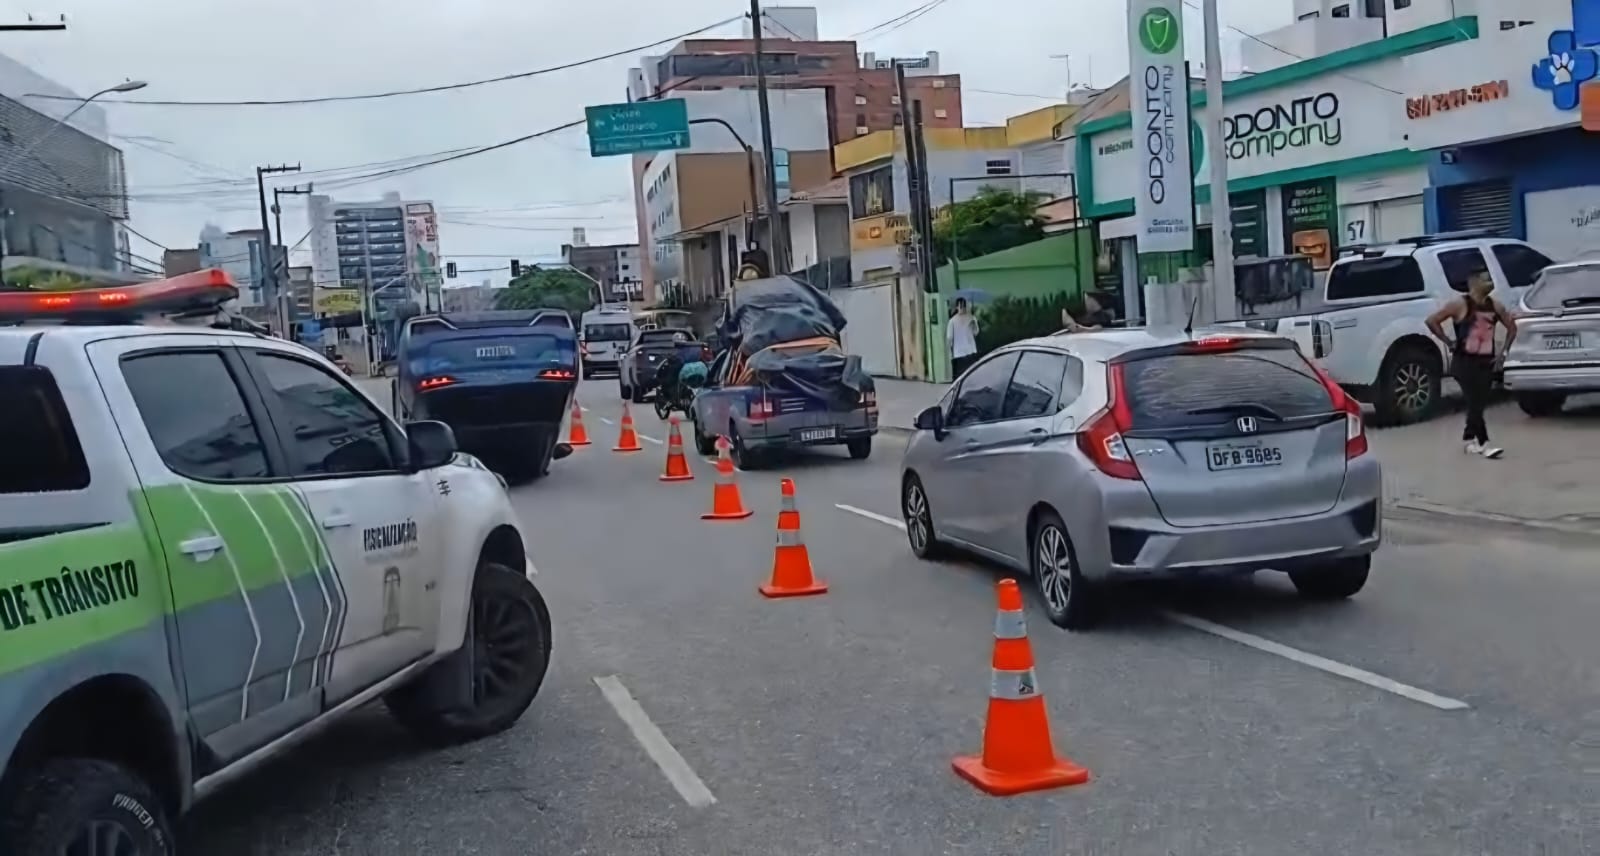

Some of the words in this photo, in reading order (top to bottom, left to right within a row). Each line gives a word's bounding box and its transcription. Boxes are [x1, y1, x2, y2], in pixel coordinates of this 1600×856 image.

[1145, 65, 1165, 204] ODONTO
[1162, 65, 1175, 163] company
[0, 584, 36, 631] DE
[30, 559, 139, 620] TRÂNSITO
